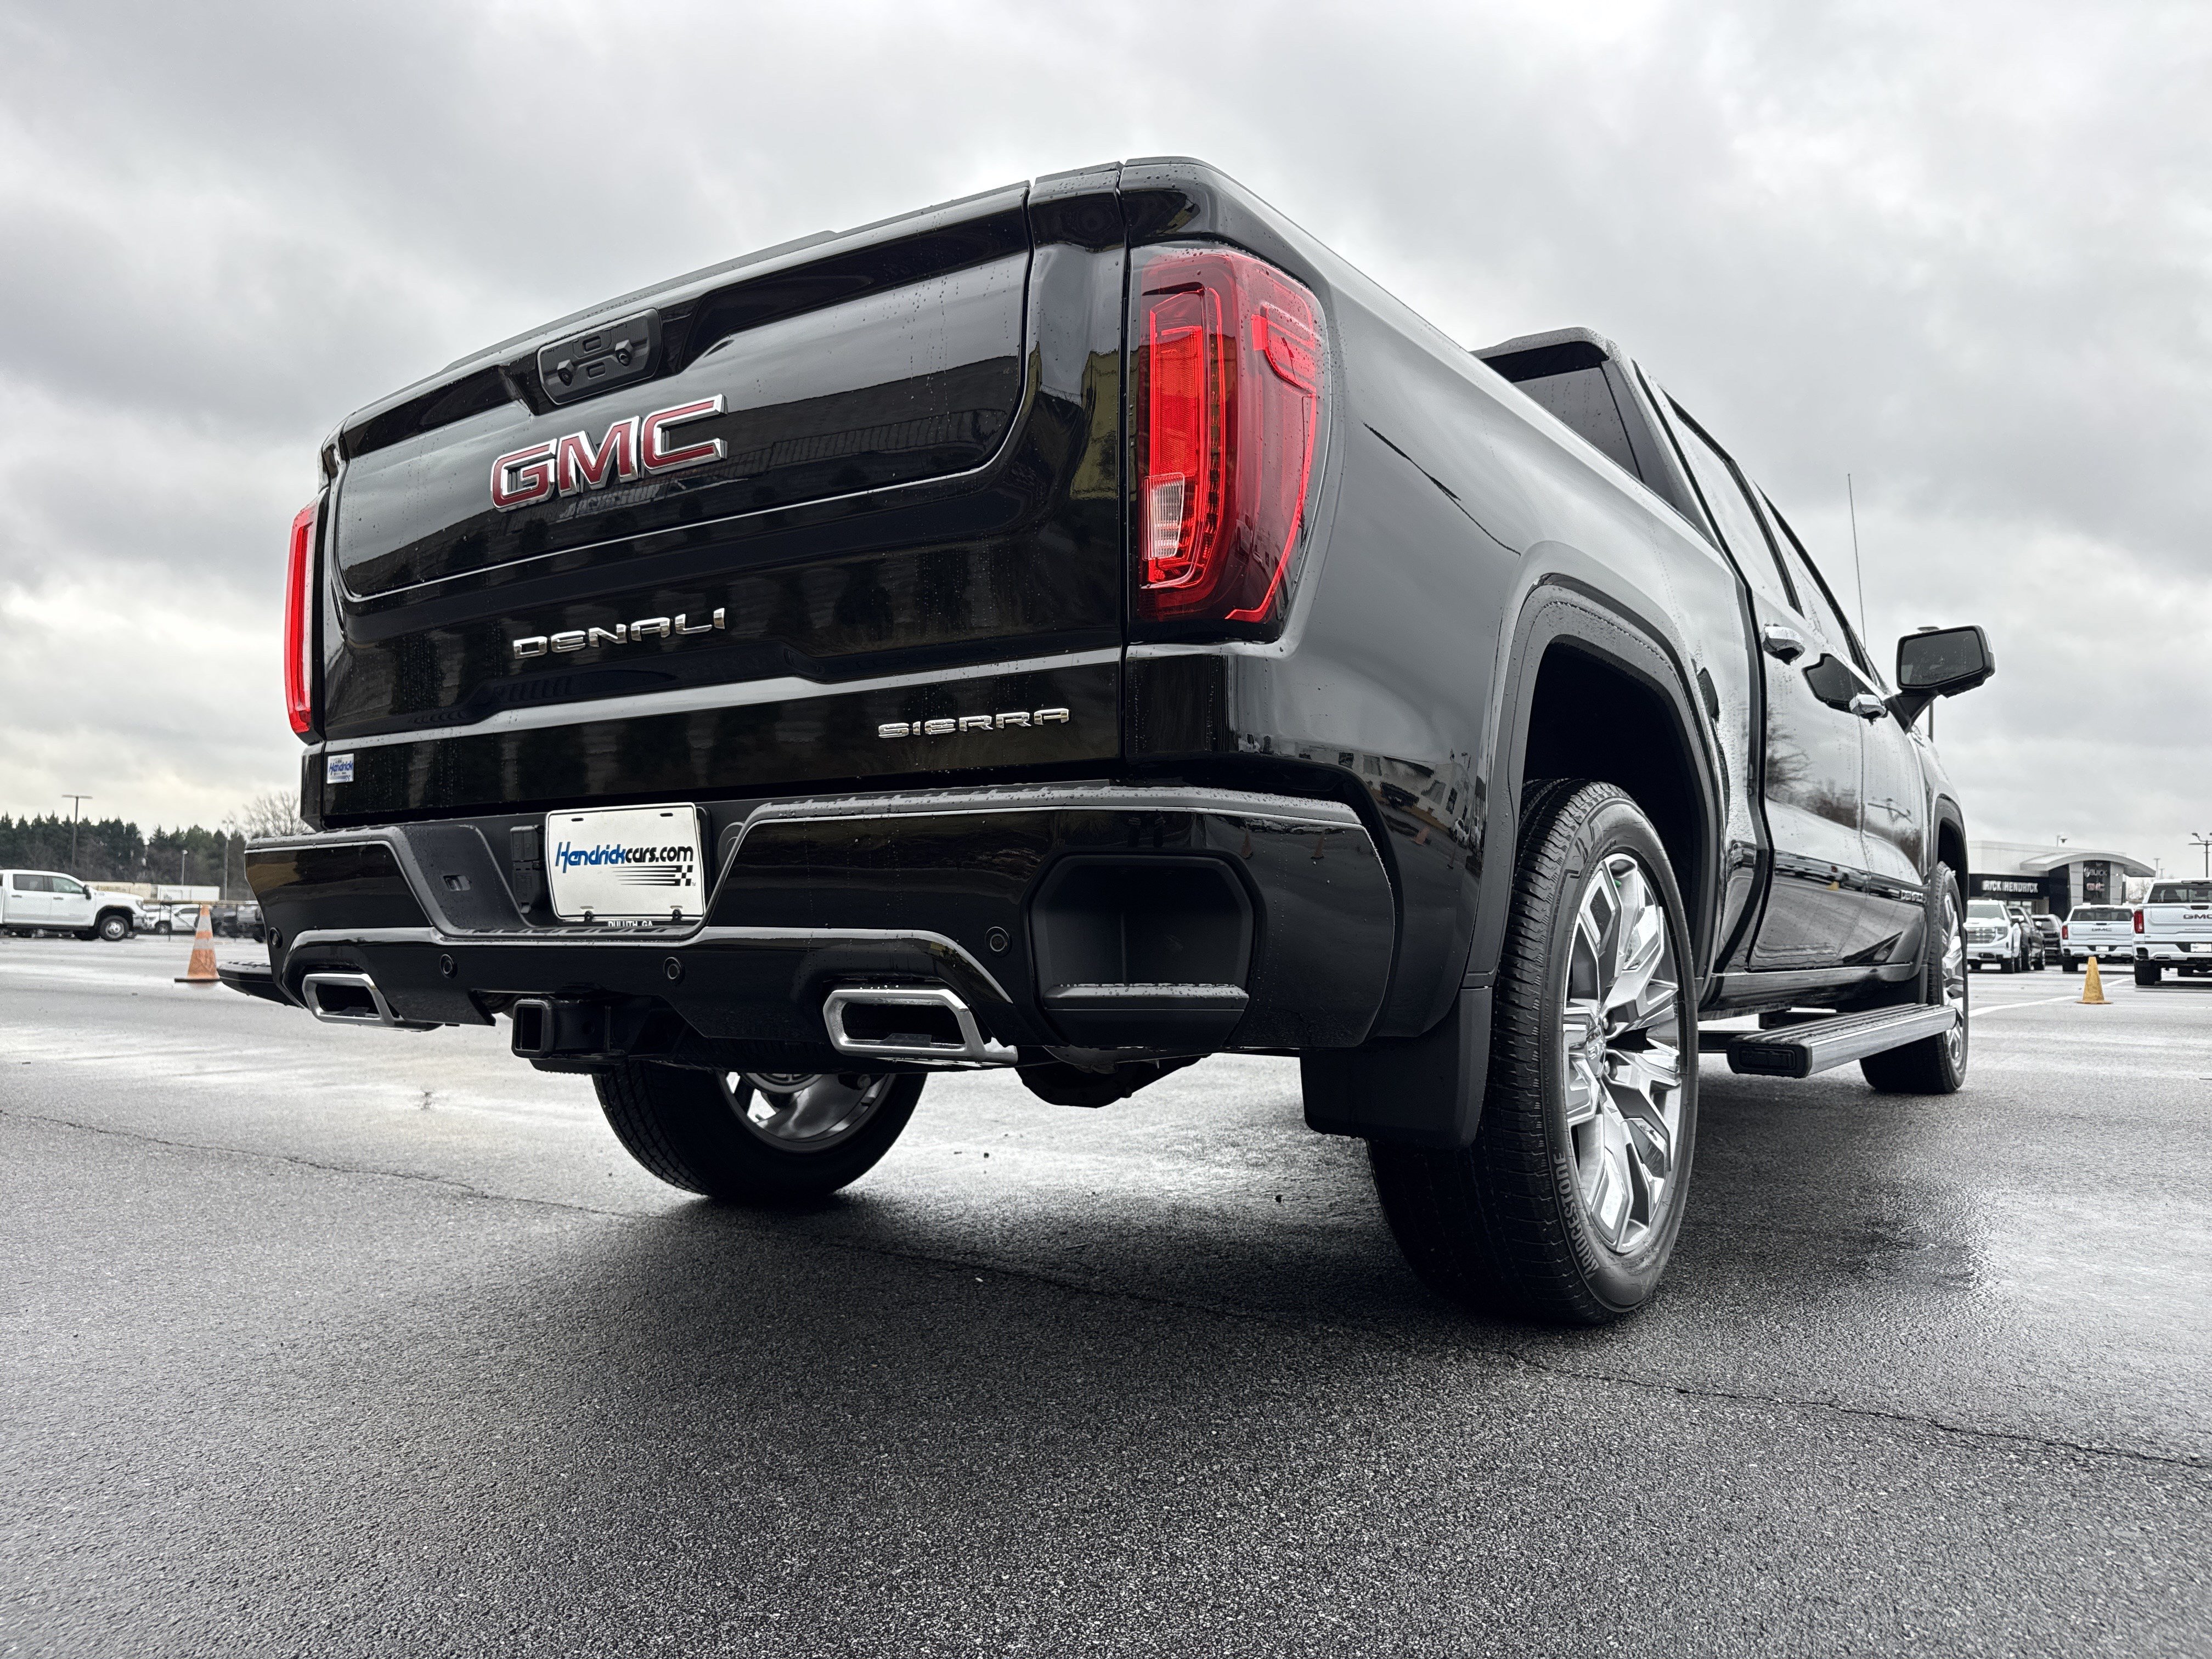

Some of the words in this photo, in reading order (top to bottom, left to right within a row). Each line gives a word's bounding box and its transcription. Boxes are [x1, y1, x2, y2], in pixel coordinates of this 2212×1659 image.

[490, 393, 728, 512] GMC
[514, 607, 726, 659] DENALI
[878, 708, 1069, 738] SIERRA
[555, 841, 693, 873] Hendrickcars.com
[1553, 1151, 1600, 1280] BRIDGESTONE
